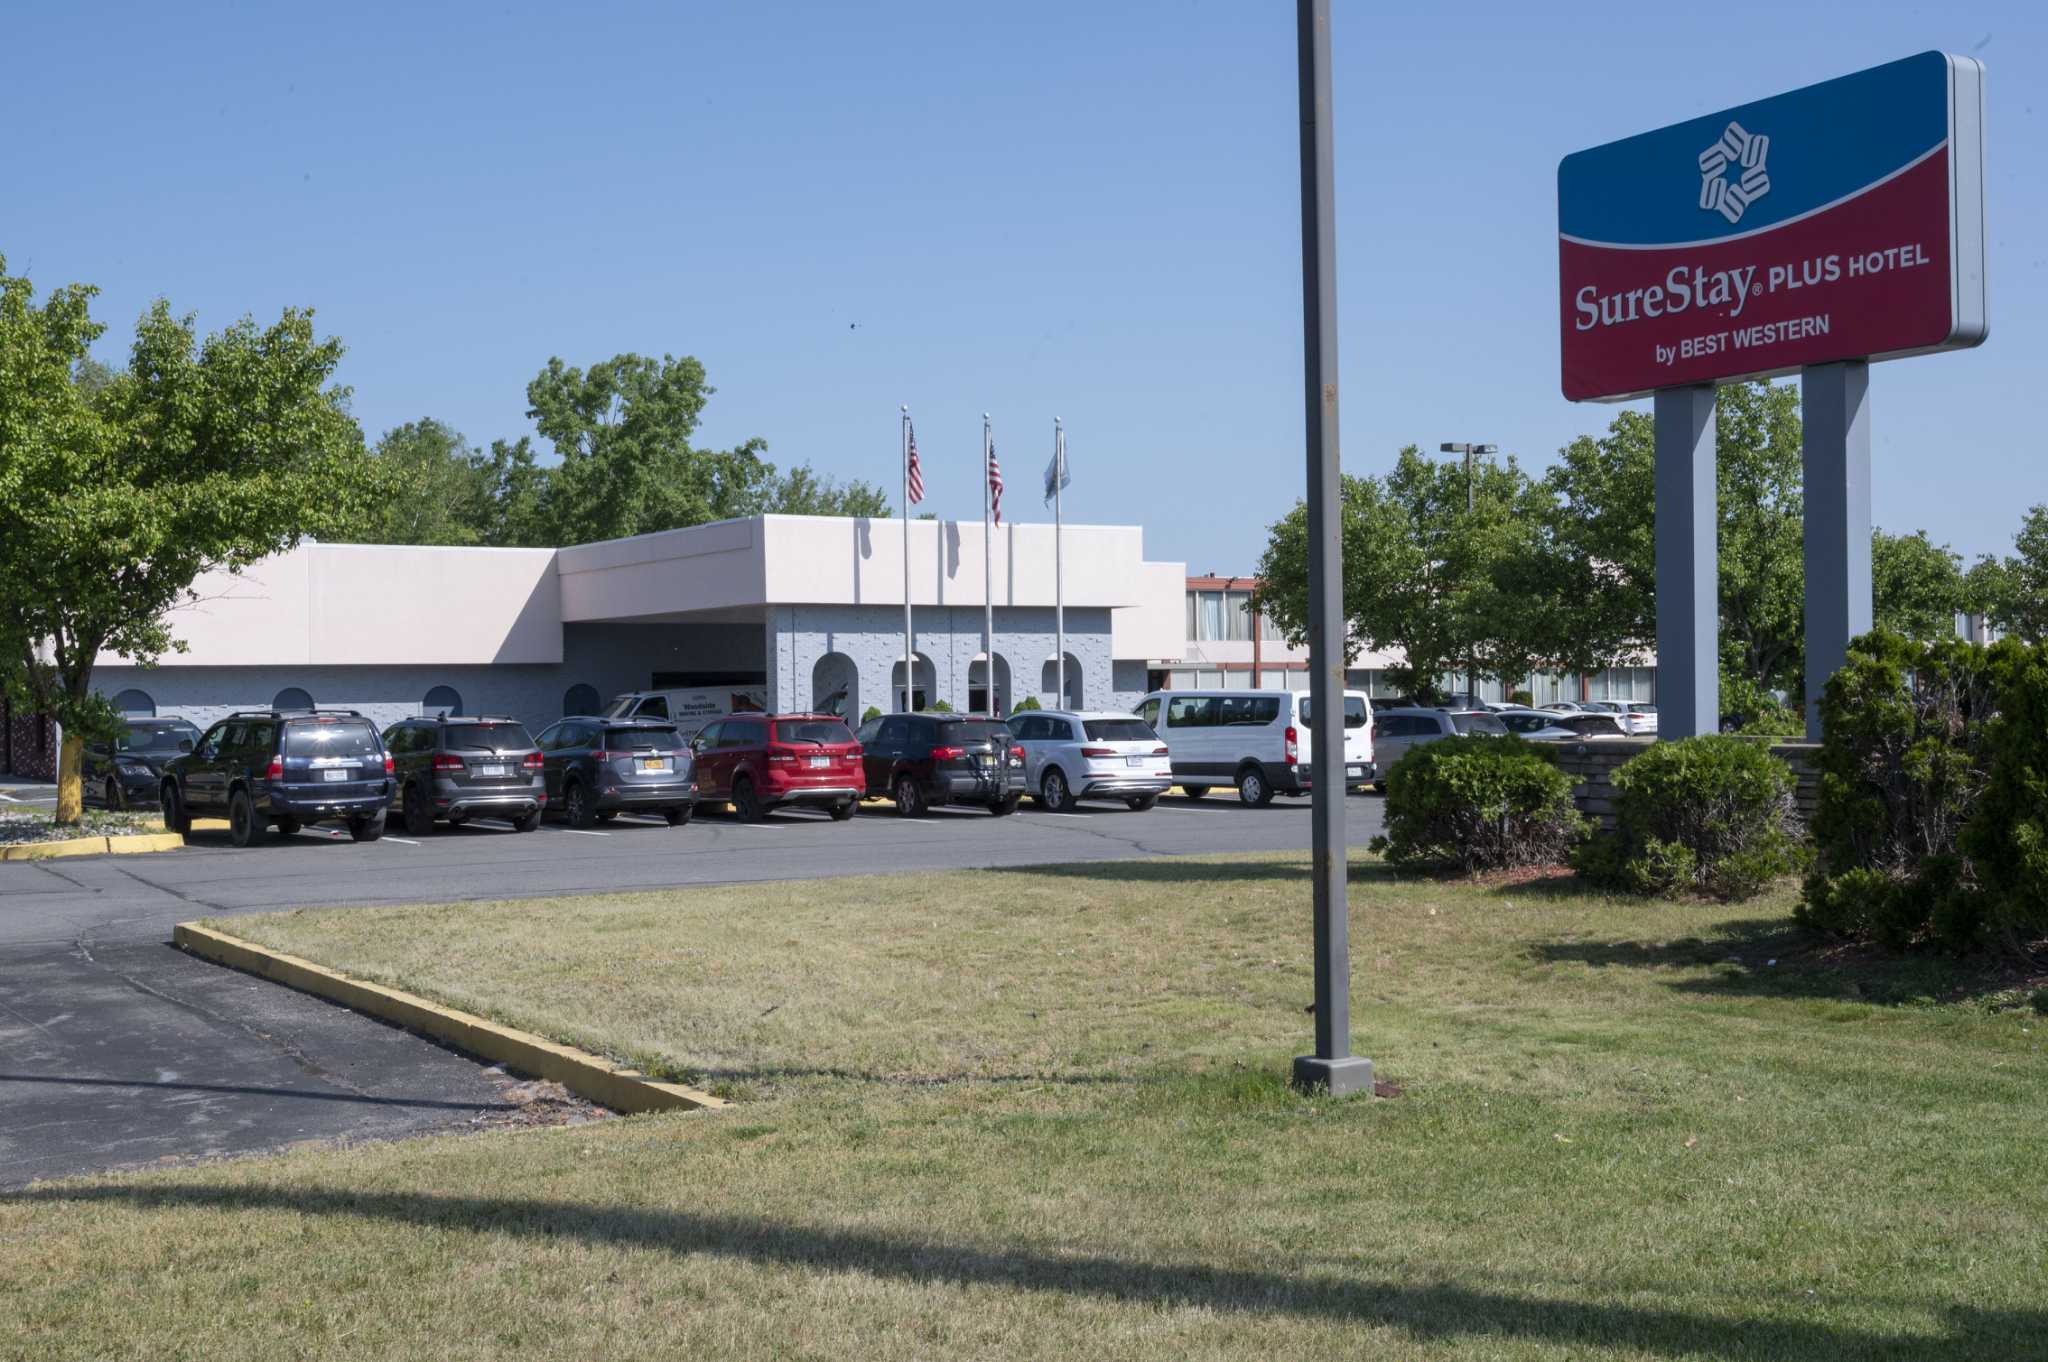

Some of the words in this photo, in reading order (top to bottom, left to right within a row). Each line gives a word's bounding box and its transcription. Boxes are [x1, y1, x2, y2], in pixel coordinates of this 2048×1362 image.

[1769, 255, 1841, 293] PLUS
[1849, 243, 1929, 277] HOTEL
[1656, 345, 1676, 366] by
[1681, 333, 1729, 358] BEST
[1733, 314, 1829, 349] WESTERN
